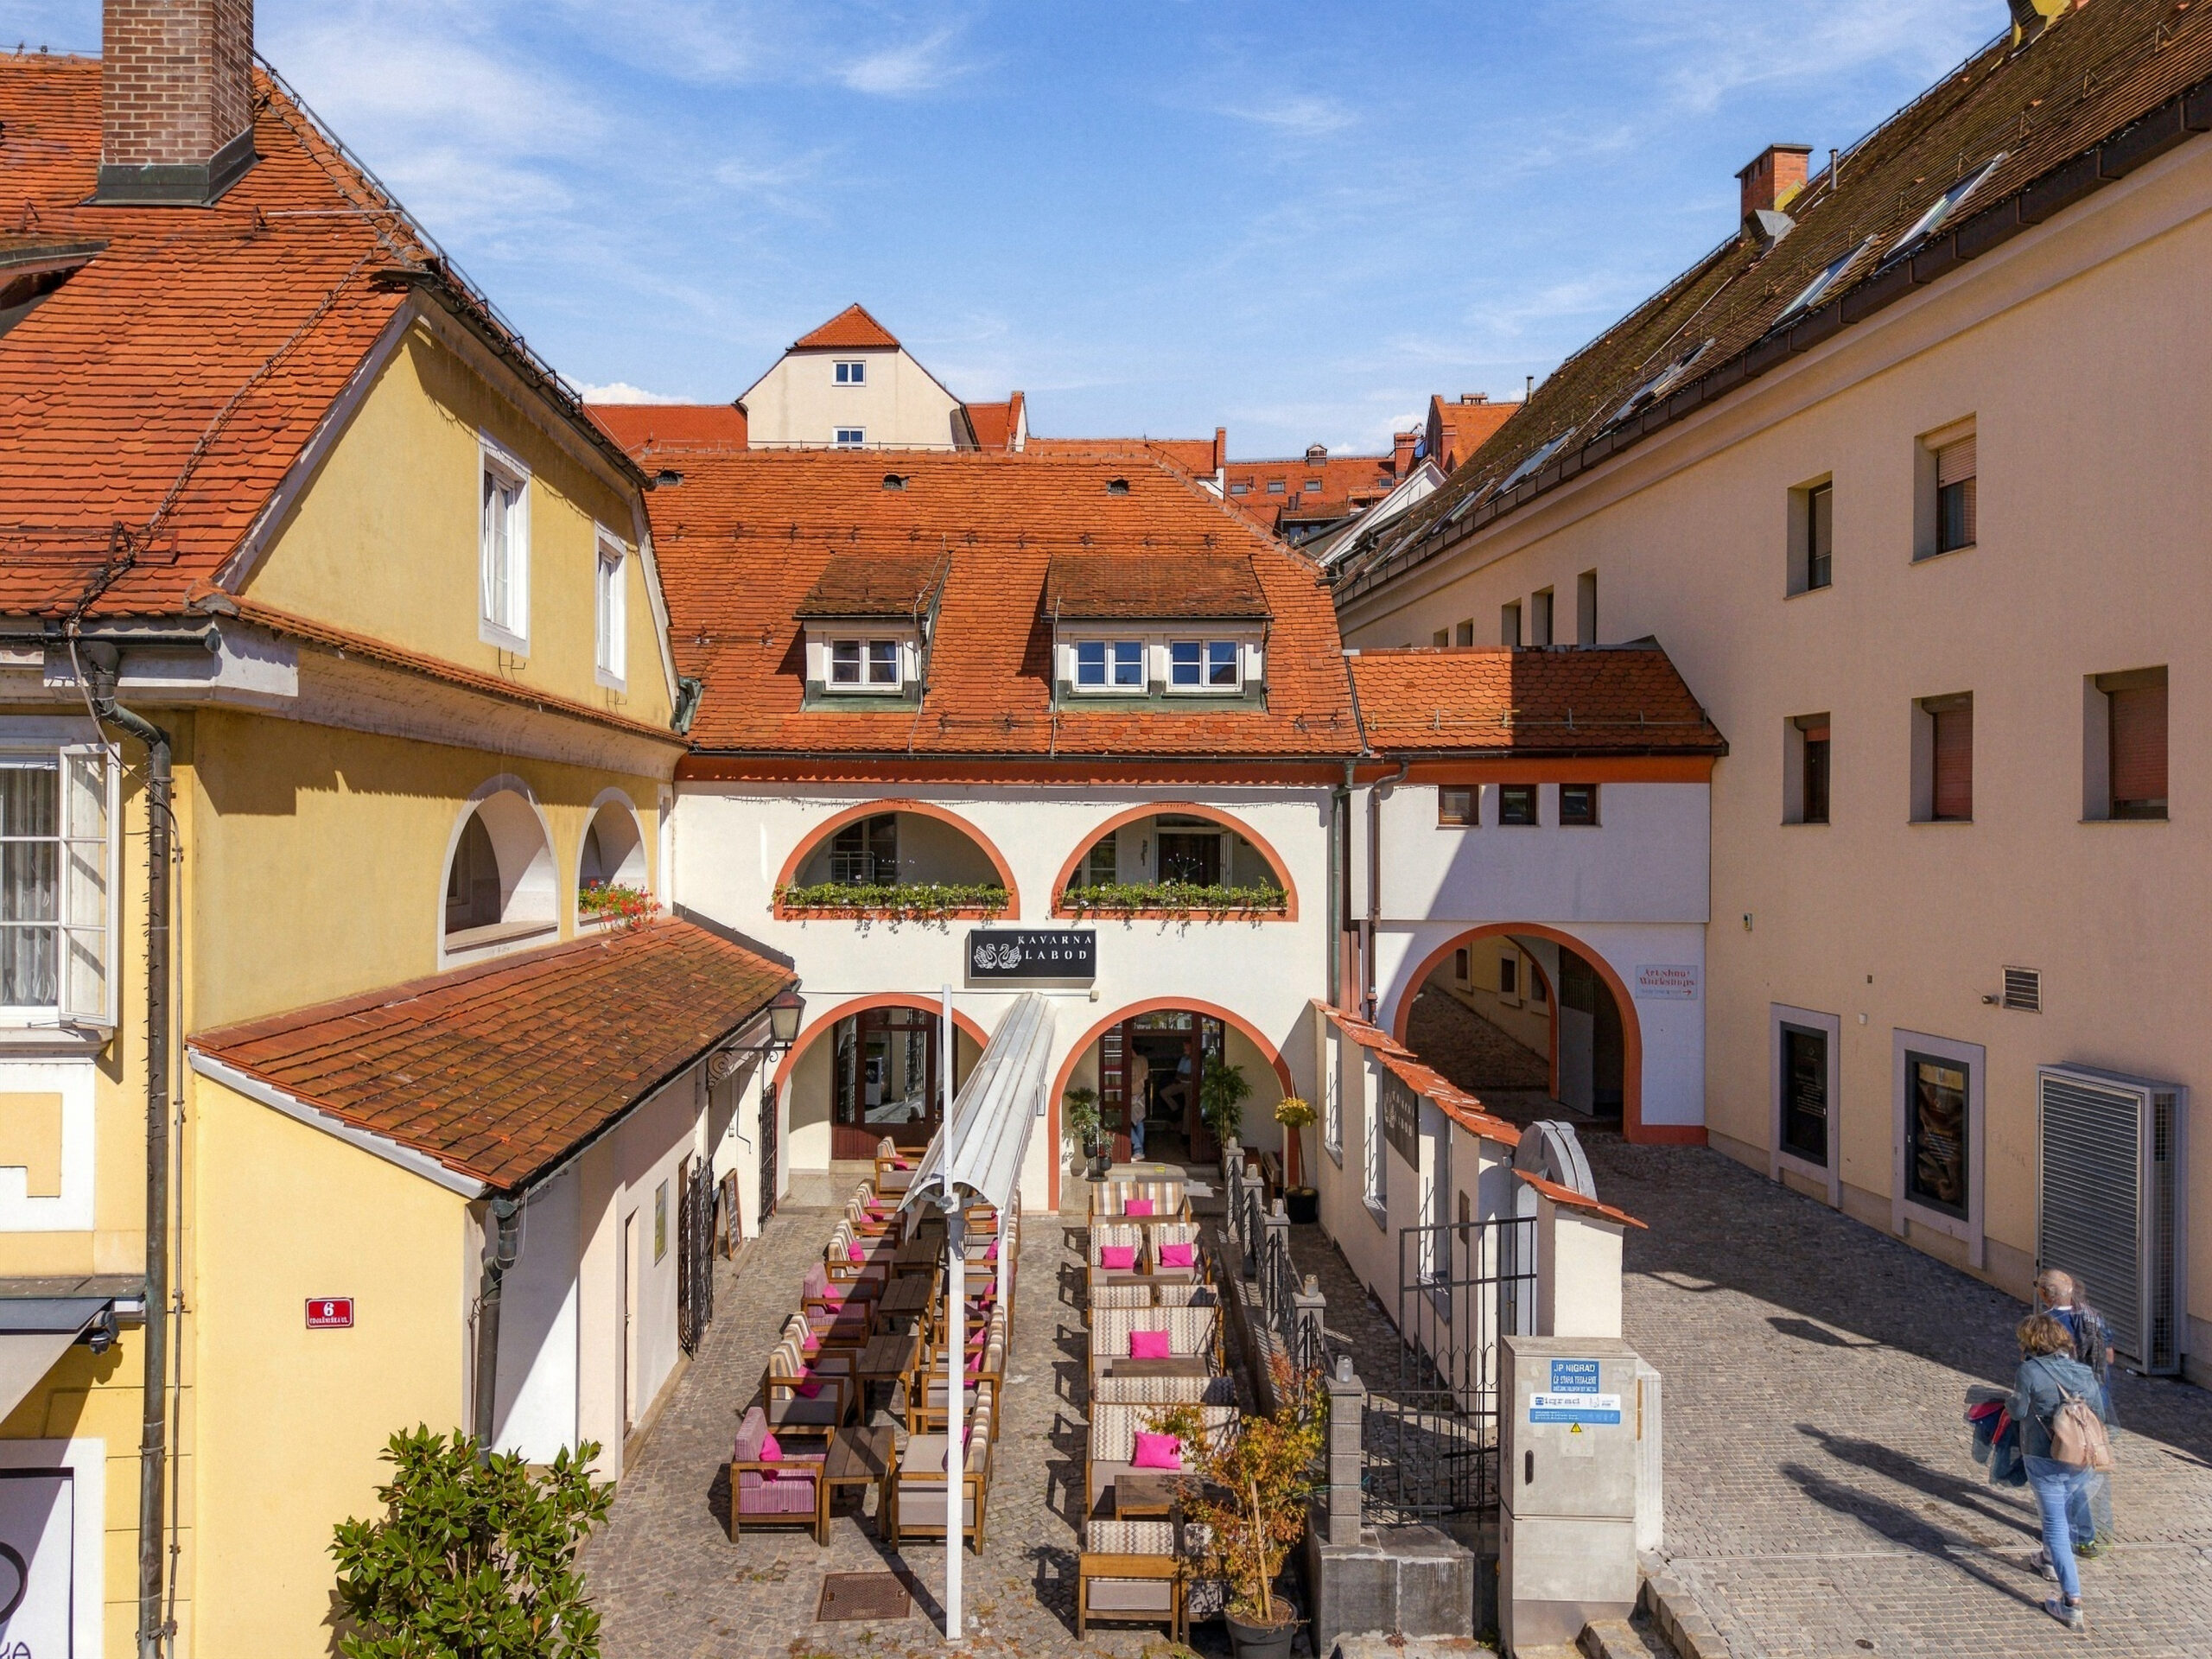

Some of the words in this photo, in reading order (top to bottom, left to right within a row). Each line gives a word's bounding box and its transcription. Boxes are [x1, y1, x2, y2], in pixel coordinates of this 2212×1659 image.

[1017, 936, 1092, 944] KAVARNA
[1025, 950, 1087, 960] LABOD
[1639, 976, 1694, 988] Workshops
[323, 1301, 334, 1317] 6
[1566, 1364, 1596, 1373] NIGRAD
